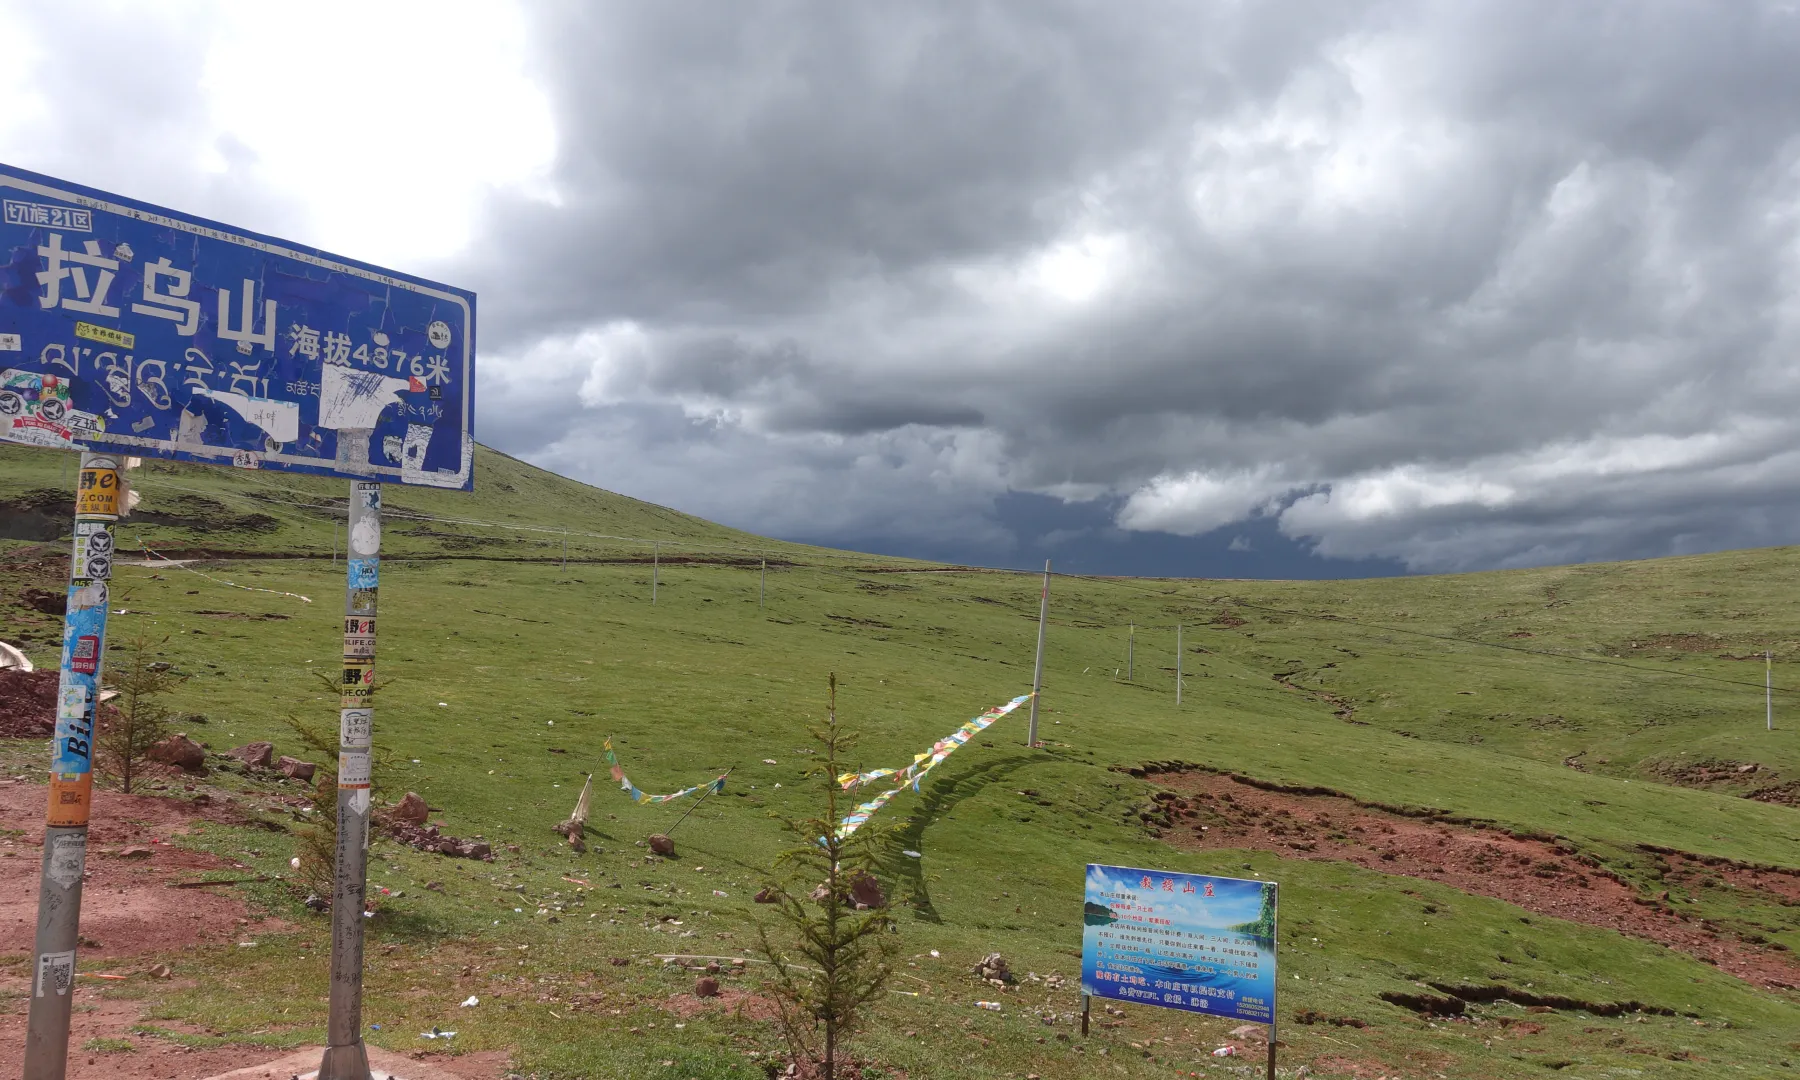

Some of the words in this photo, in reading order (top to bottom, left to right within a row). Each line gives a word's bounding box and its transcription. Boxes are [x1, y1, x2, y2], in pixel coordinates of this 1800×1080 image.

[35, 233, 277, 351] 拉乌山
[1139, 875, 1216, 898] 教授山庄
